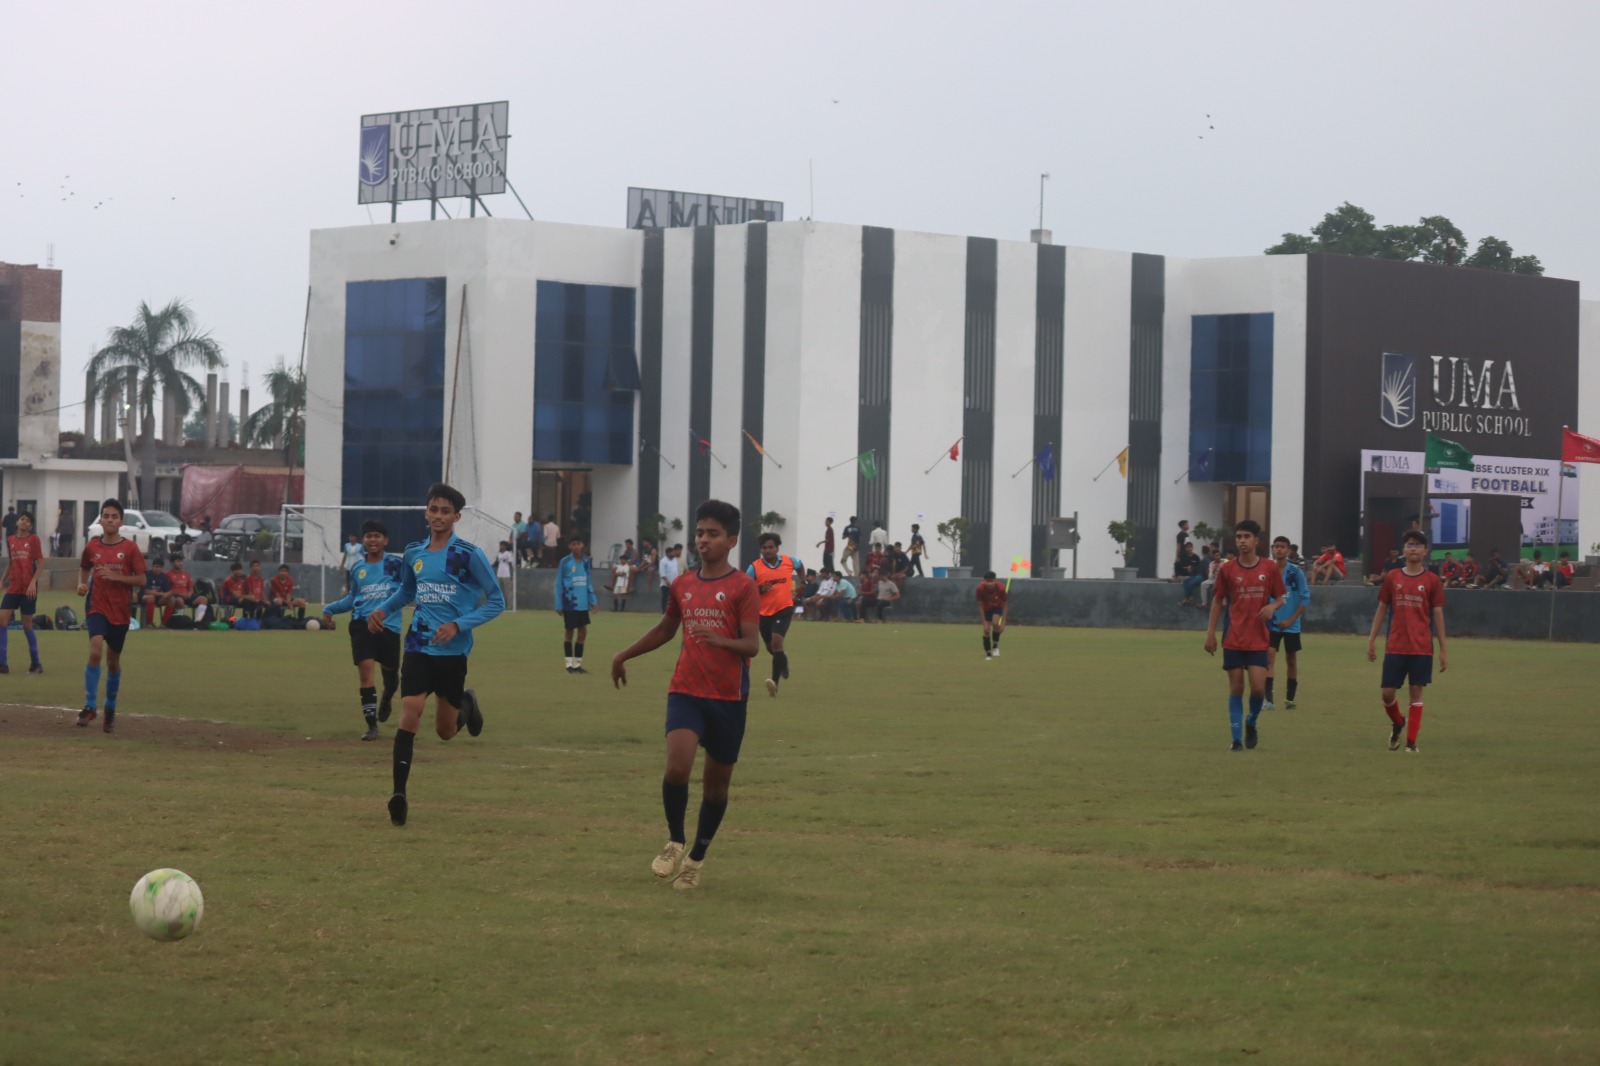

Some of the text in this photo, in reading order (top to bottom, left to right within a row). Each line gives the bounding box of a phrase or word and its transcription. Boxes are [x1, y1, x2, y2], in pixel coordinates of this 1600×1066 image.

[391, 113, 503, 160] UMA
[391, 161, 501, 185] PUBLIC SCHOOL
[1430, 355, 1520, 411] UMA
[1422, 411, 1532, 437] PUBLIC SCHOOL
[1384, 455, 1410, 469] UMA
[1475, 464, 1550, 477] BSE CLUSTER XIX
[1471, 477, 1547, 494] FOOTBALL
[694, 607, 726, 618] GOENKA
